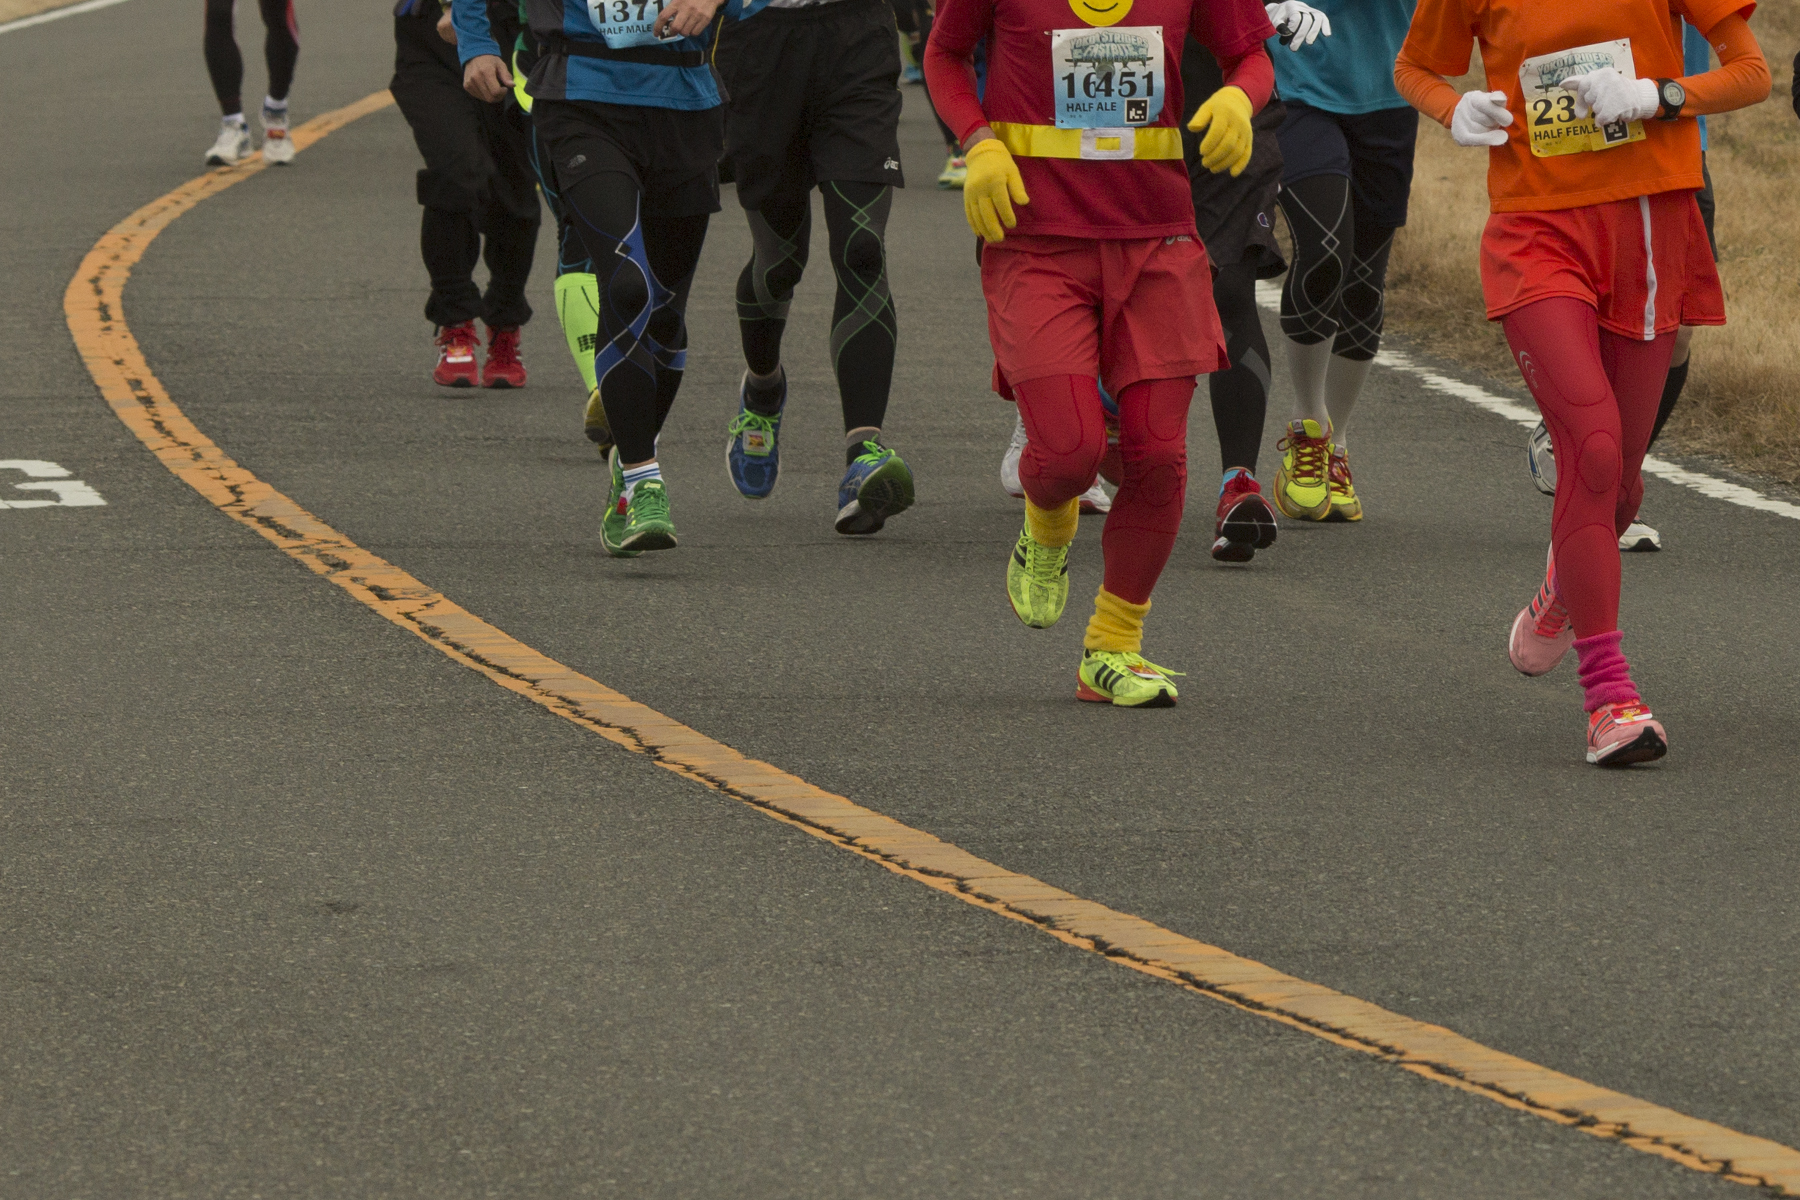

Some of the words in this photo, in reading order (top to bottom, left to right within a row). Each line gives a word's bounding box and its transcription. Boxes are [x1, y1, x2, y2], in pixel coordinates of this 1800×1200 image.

[600, 26, 624, 36] HALF
[626, 24, 652, 34] MALE
[1062, 71, 1154, 98] 16451
[1066, 102, 1094, 112] HALF
[1534, 128, 1563, 141] HALF
